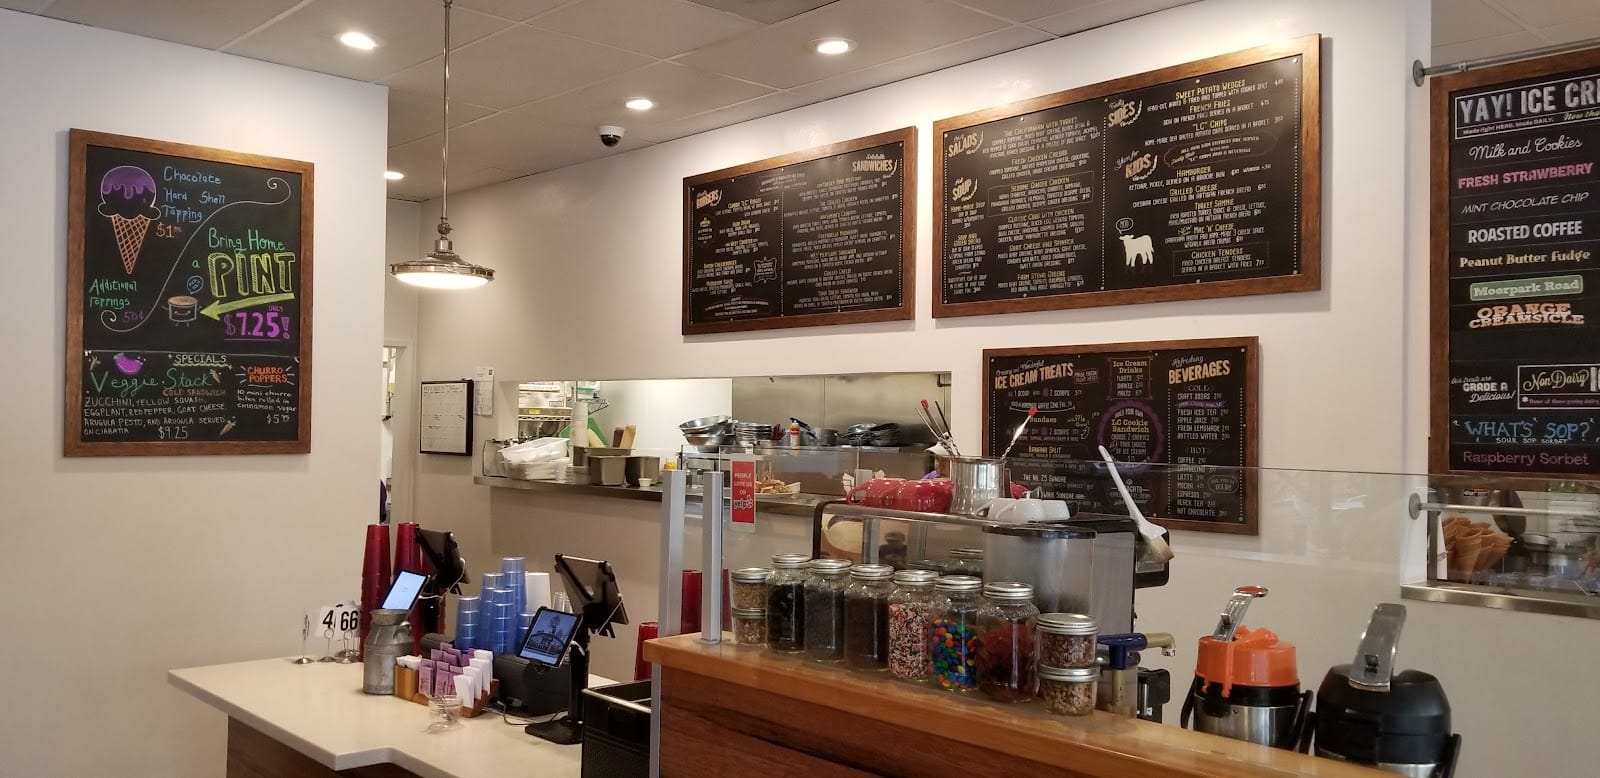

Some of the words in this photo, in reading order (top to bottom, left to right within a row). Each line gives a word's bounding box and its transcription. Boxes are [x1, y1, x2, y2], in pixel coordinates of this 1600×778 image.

[1176, 90, 1194, 100] SWEET
[1197, 84, 1220, 96] POTATO
[1222, 79, 1246, 90] WEDGES
[1190, 104, 1212, 114] FRENCH
[1214, 99, 1231, 110] FRIES
[1460, 92, 1512, 124] YAY!
[1520, 86, 1556, 115] ICE
[1564, 79, 1600, 108] CR
[1108, 101, 1136, 127] SIDES
[948, 133, 978, 158] SALADS
[1469, 144, 1506, 160] Milk
[1508, 140, 1531, 156] and
[1534, 134, 1583, 152] Cookies
[164, 166, 221, 184] Chocolate
[852, 159, 893, 172] SANDWICHES
[1126, 153, 1151, 178] KIDS
[1176, 166, 1212, 178] HAMBURGER
[1458, 174, 1499, 189] FRESH
[1503, 162, 1594, 184] STRAWBERRY
[164, 188, 188, 200] Hard
[200, 192, 226, 204] Shell
[952, 178, 972, 202] SOUP
[1170, 186, 1194, 196] GRILLED
[1195, 183, 1218, 194] CHEESE
[1461, 203, 1488, 214] MINT
[1490, 195, 1560, 211] CHOCOLATE
[1562, 192, 1590, 204] CHIP
[162, 204, 202, 223] Topping
[208, 227, 246, 253] Bring
[248, 228, 286, 250] Home
[1468, 226, 1530, 244] ROASTED
[1533, 220, 1583, 238] COFFEE
[1192, 250, 1216, 260] CHICKEN
[1460, 256, 1503, 268] Peanut
[1506, 253, 1548, 265] Butter
[1552, 250, 1592, 262] Fudge
[208, 252, 296, 297] PINT
[90, 278, 138, 294] Additional
[1472, 284, 1542, 298] Moorpark
[1544, 279, 1580, 291] Road
[1477, 302, 1572, 319] ORANGE
[224, 312, 290, 340] $7.25!
[1468, 313, 1585, 329] CREAMSICLE
[175, 354, 228, 364] SPECIALS
[247, 366, 284, 375] CHURRO
[249, 374, 288, 384] POPPERS
[994, 375, 1008, 390] ICE
[1009, 370, 1039, 386] CREAM
[1040, 362, 1074, 380] TREATS
[1168, 360, 1230, 384] BEVERAGES
[91, 370, 158, 398] Veggie
[164, 368, 212, 390] Stack
[1462, 382, 1498, 392] GRADE
[1500, 382, 1508, 392] A
[1469, 390, 1517, 404] Delicious!
[84, 418, 116, 428] ARUGULA
[1544, 422, 1590, 442] SOP?
[1463, 451, 1536, 466] Raspberry
[1539, 452, 1591, 466] Sorbet
[340, 610, 359, 631] 66
